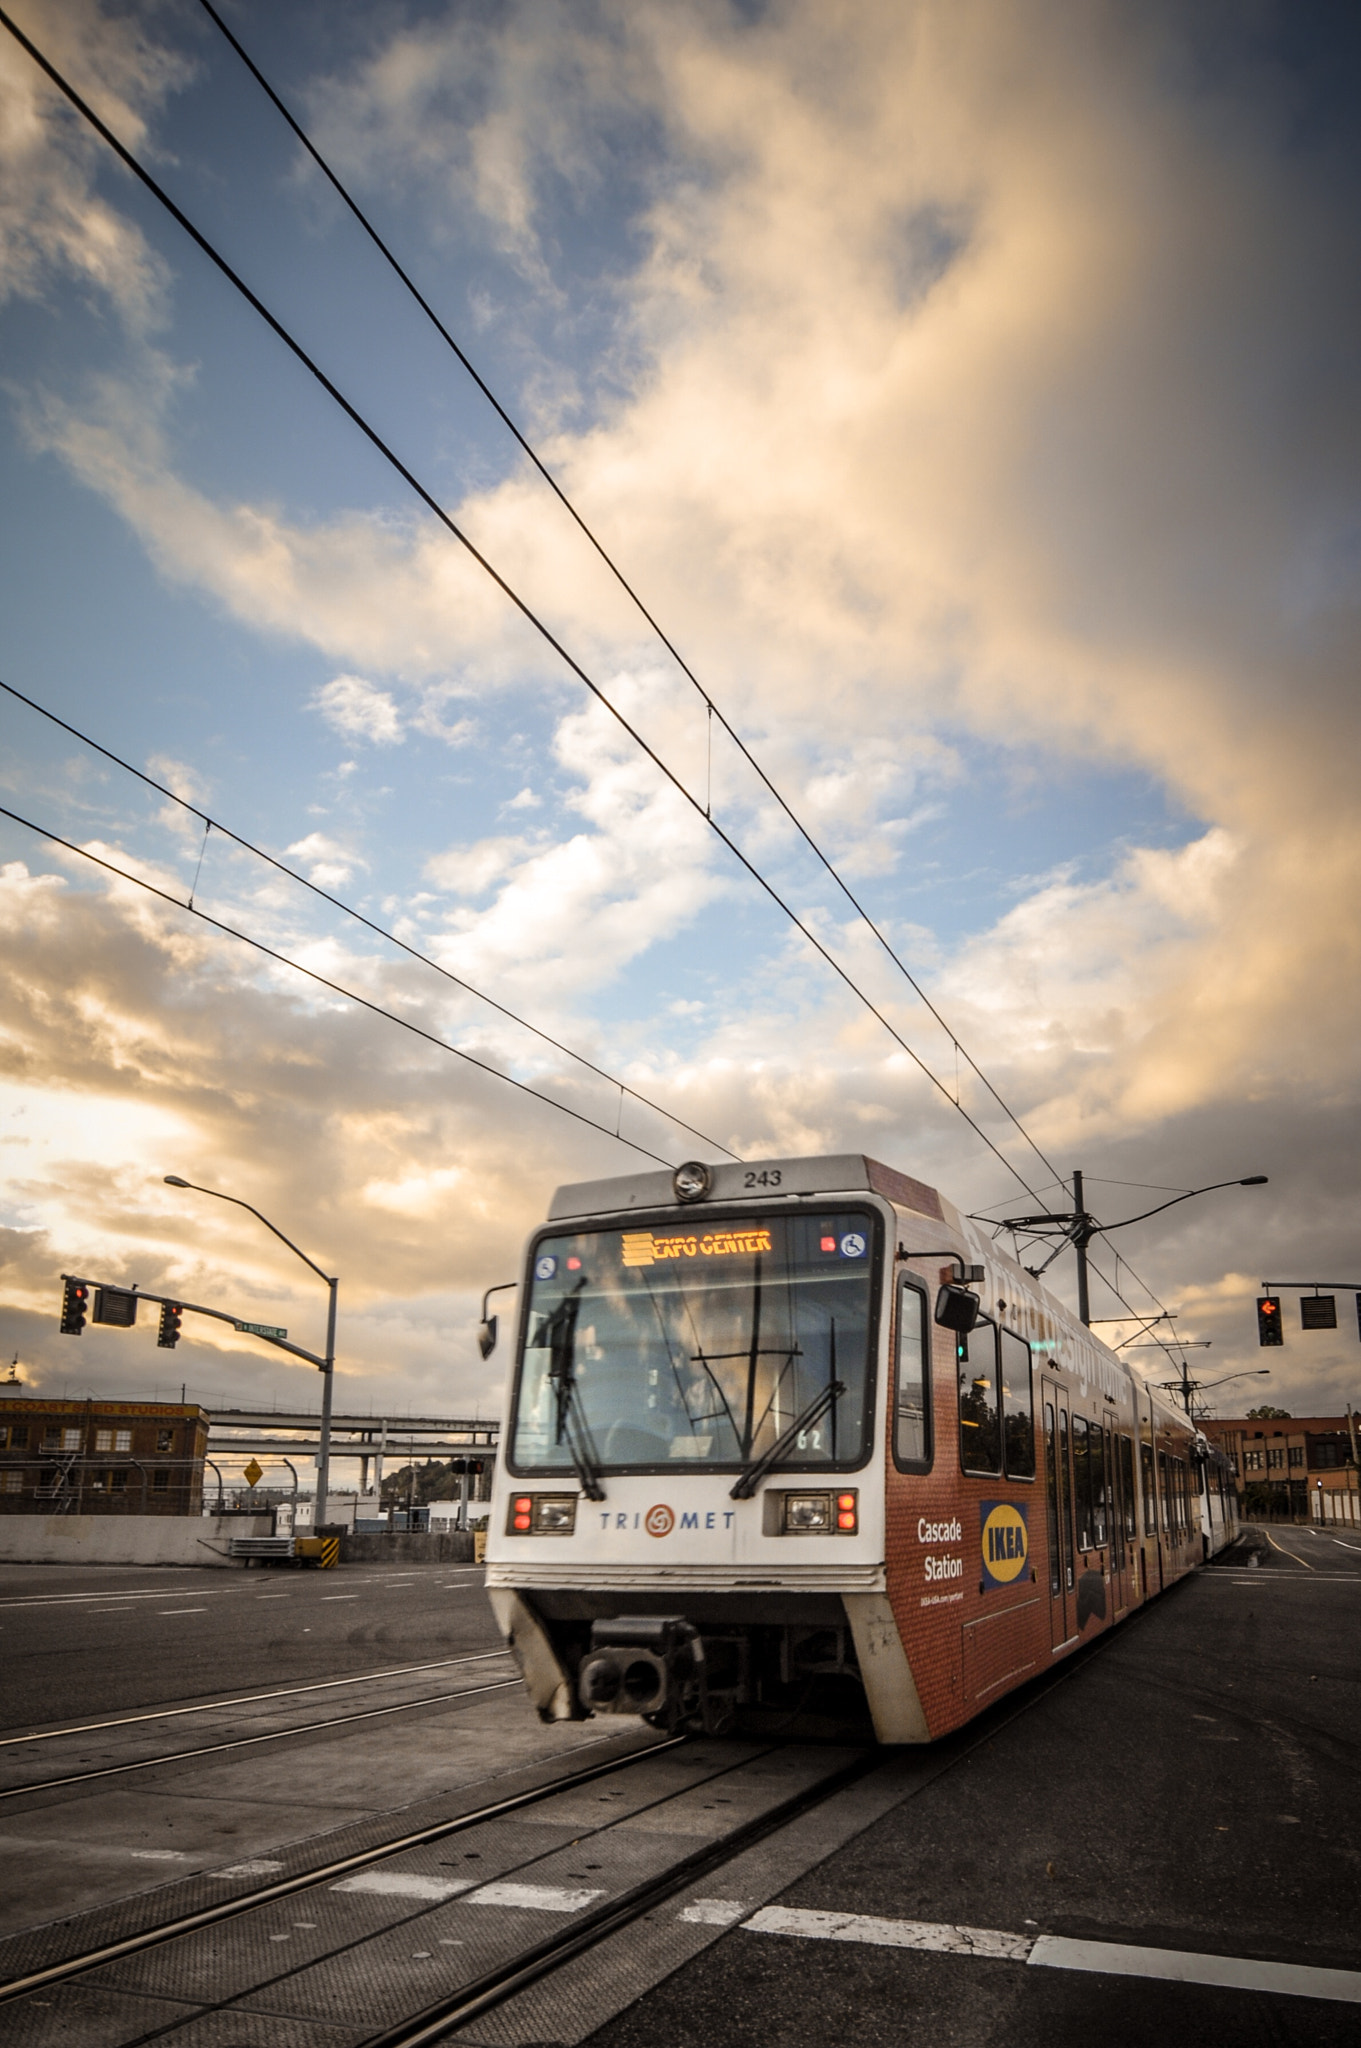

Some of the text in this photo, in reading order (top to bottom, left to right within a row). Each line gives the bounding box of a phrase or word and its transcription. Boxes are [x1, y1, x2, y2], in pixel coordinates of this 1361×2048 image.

[744, 1170, 782, 1188] 243
[652, 1230, 772, 1260] EXPO CENTER
[12, 1402, 69, 1412] COAST
[118, 1404, 184, 1415] STUDIOS
[797, 1429, 821, 1450] 62
[918, 1516, 963, 1544] Cascade
[987, 1526, 1024, 1563] IKEA
[924, 1554, 963, 1582] Station
